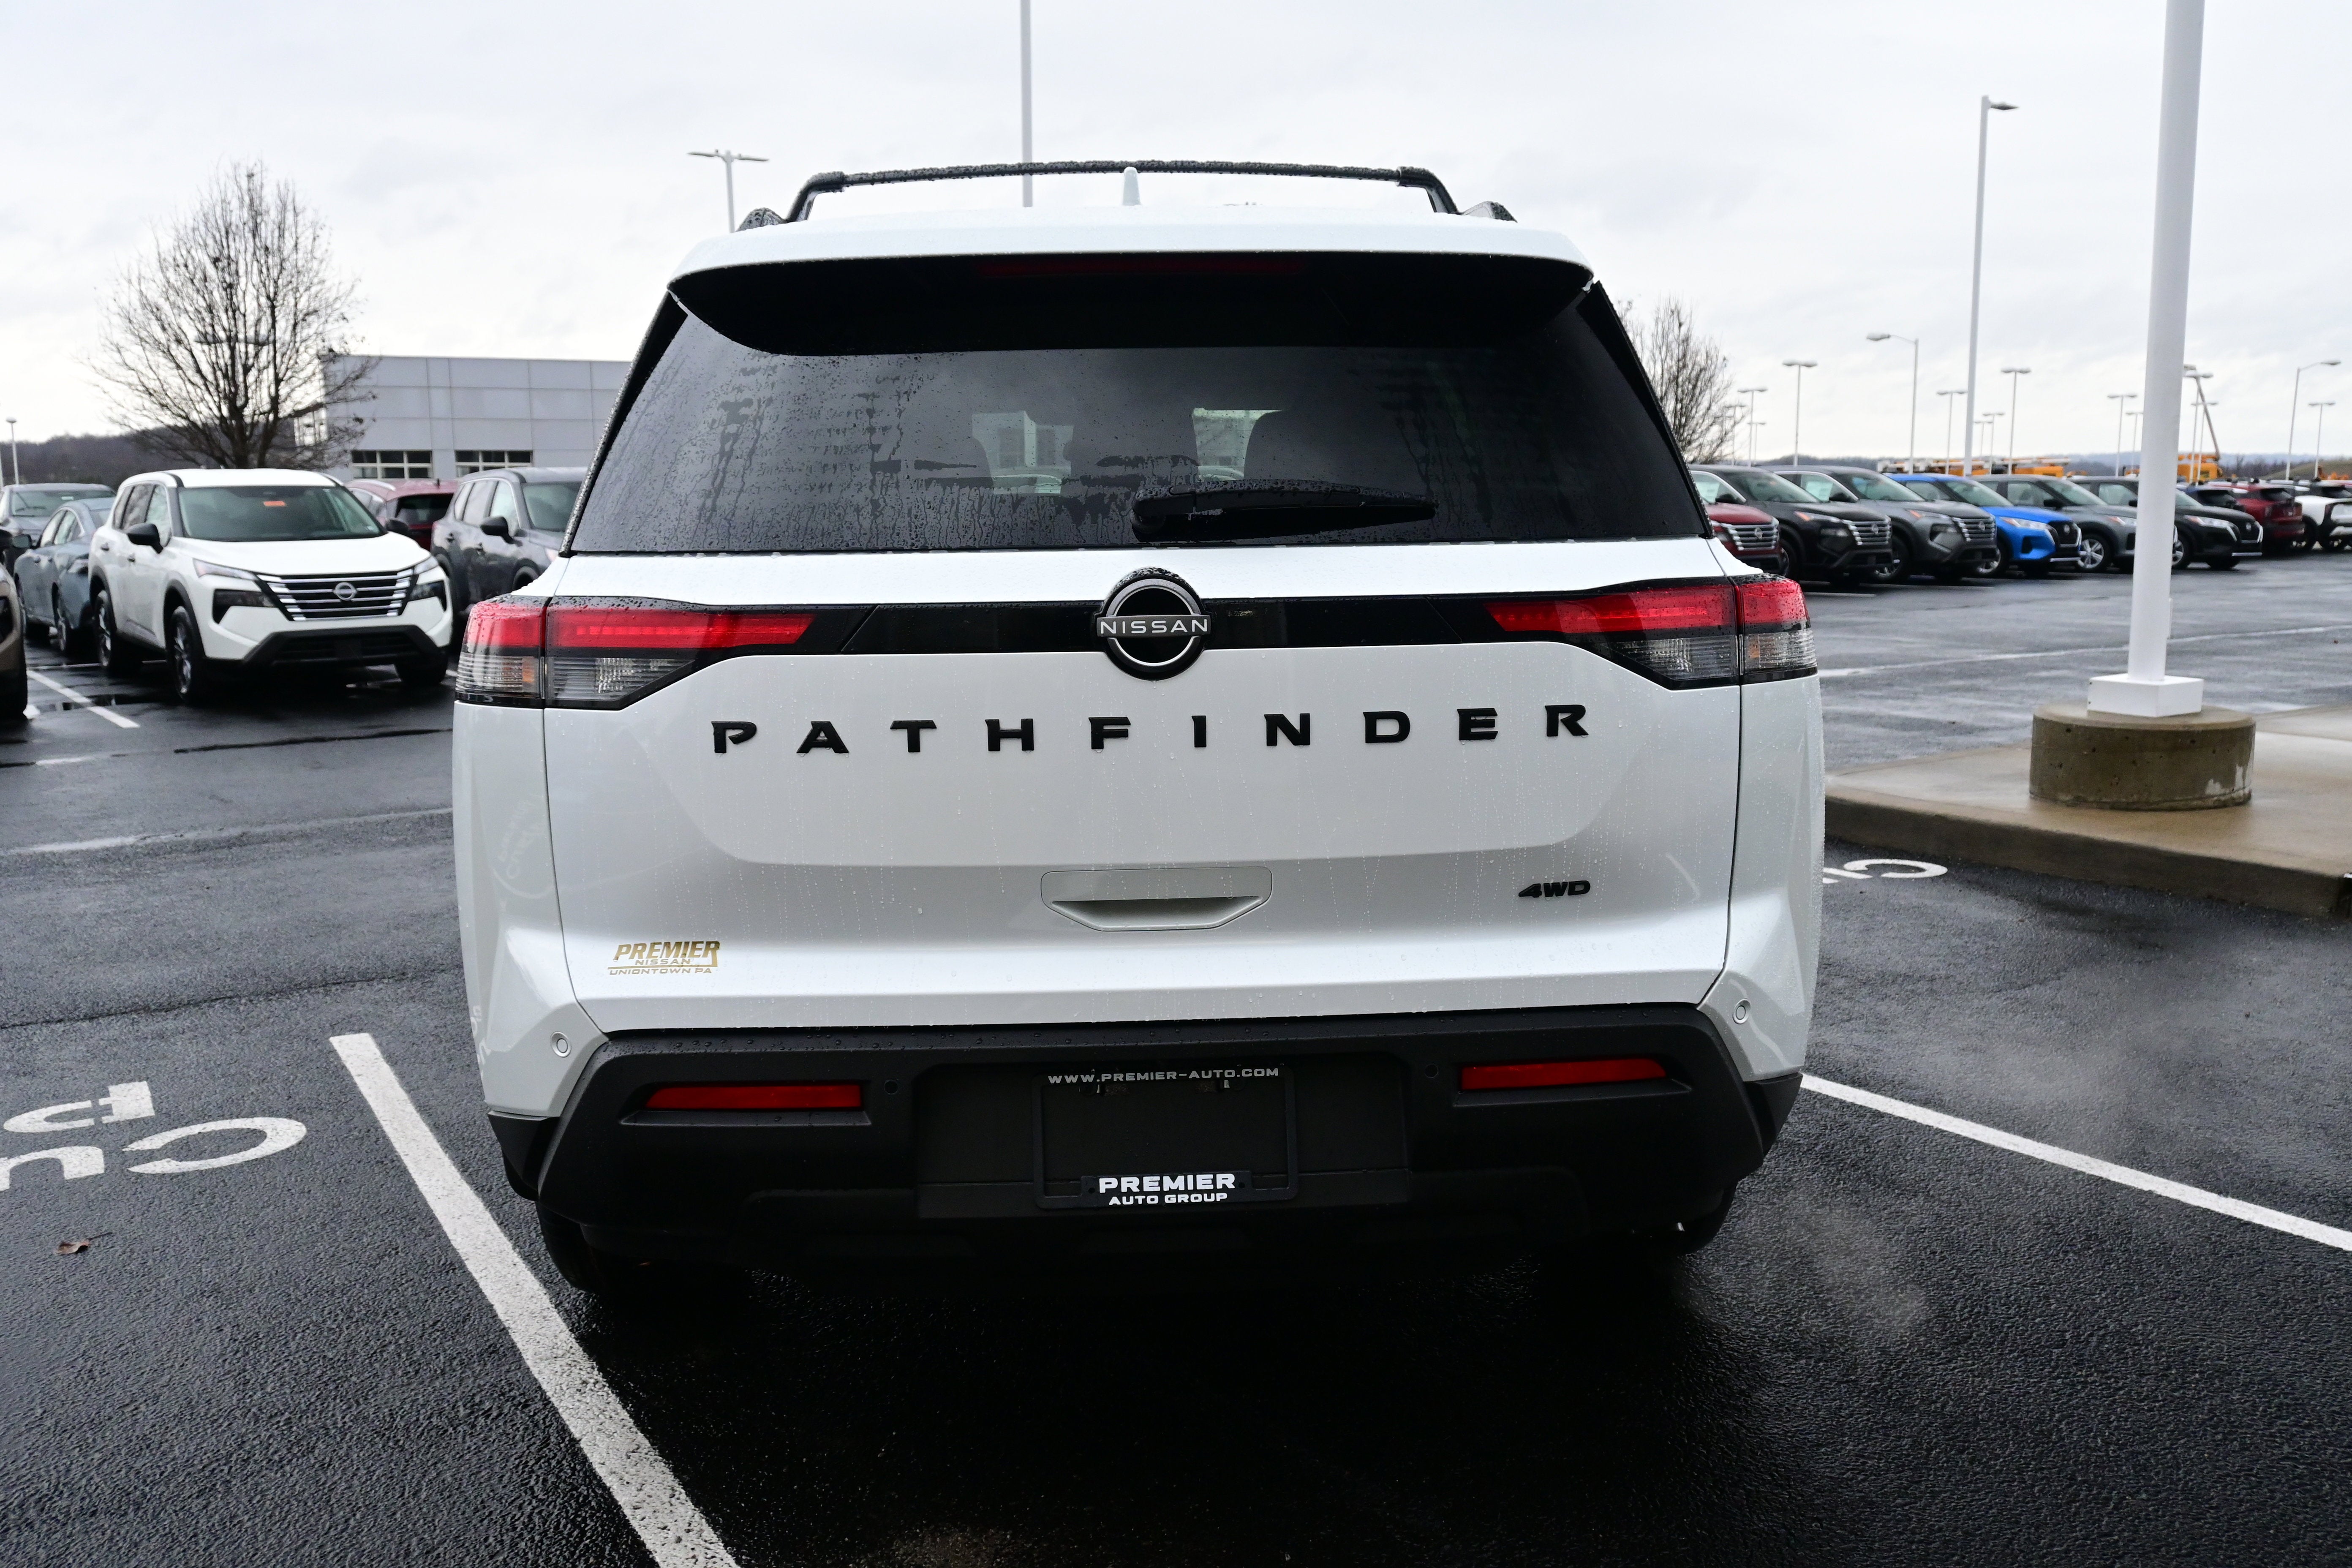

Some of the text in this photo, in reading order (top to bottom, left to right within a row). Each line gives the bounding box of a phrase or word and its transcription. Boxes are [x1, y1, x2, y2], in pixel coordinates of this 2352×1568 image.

[1100, 619, 1207, 634] NISSAN
[711, 705, 1589, 754] PATHFINDER
[1518, 880, 1591, 898] 4WD
[612, 941, 720, 961] PREMIER
[1048, 1068, 1279, 1084] WWW.PREMIER-AUTO.COM
[1099, 1173, 1236, 1193] PREMIER
[1108, 1192, 1228, 1205] AUTO GROUP
